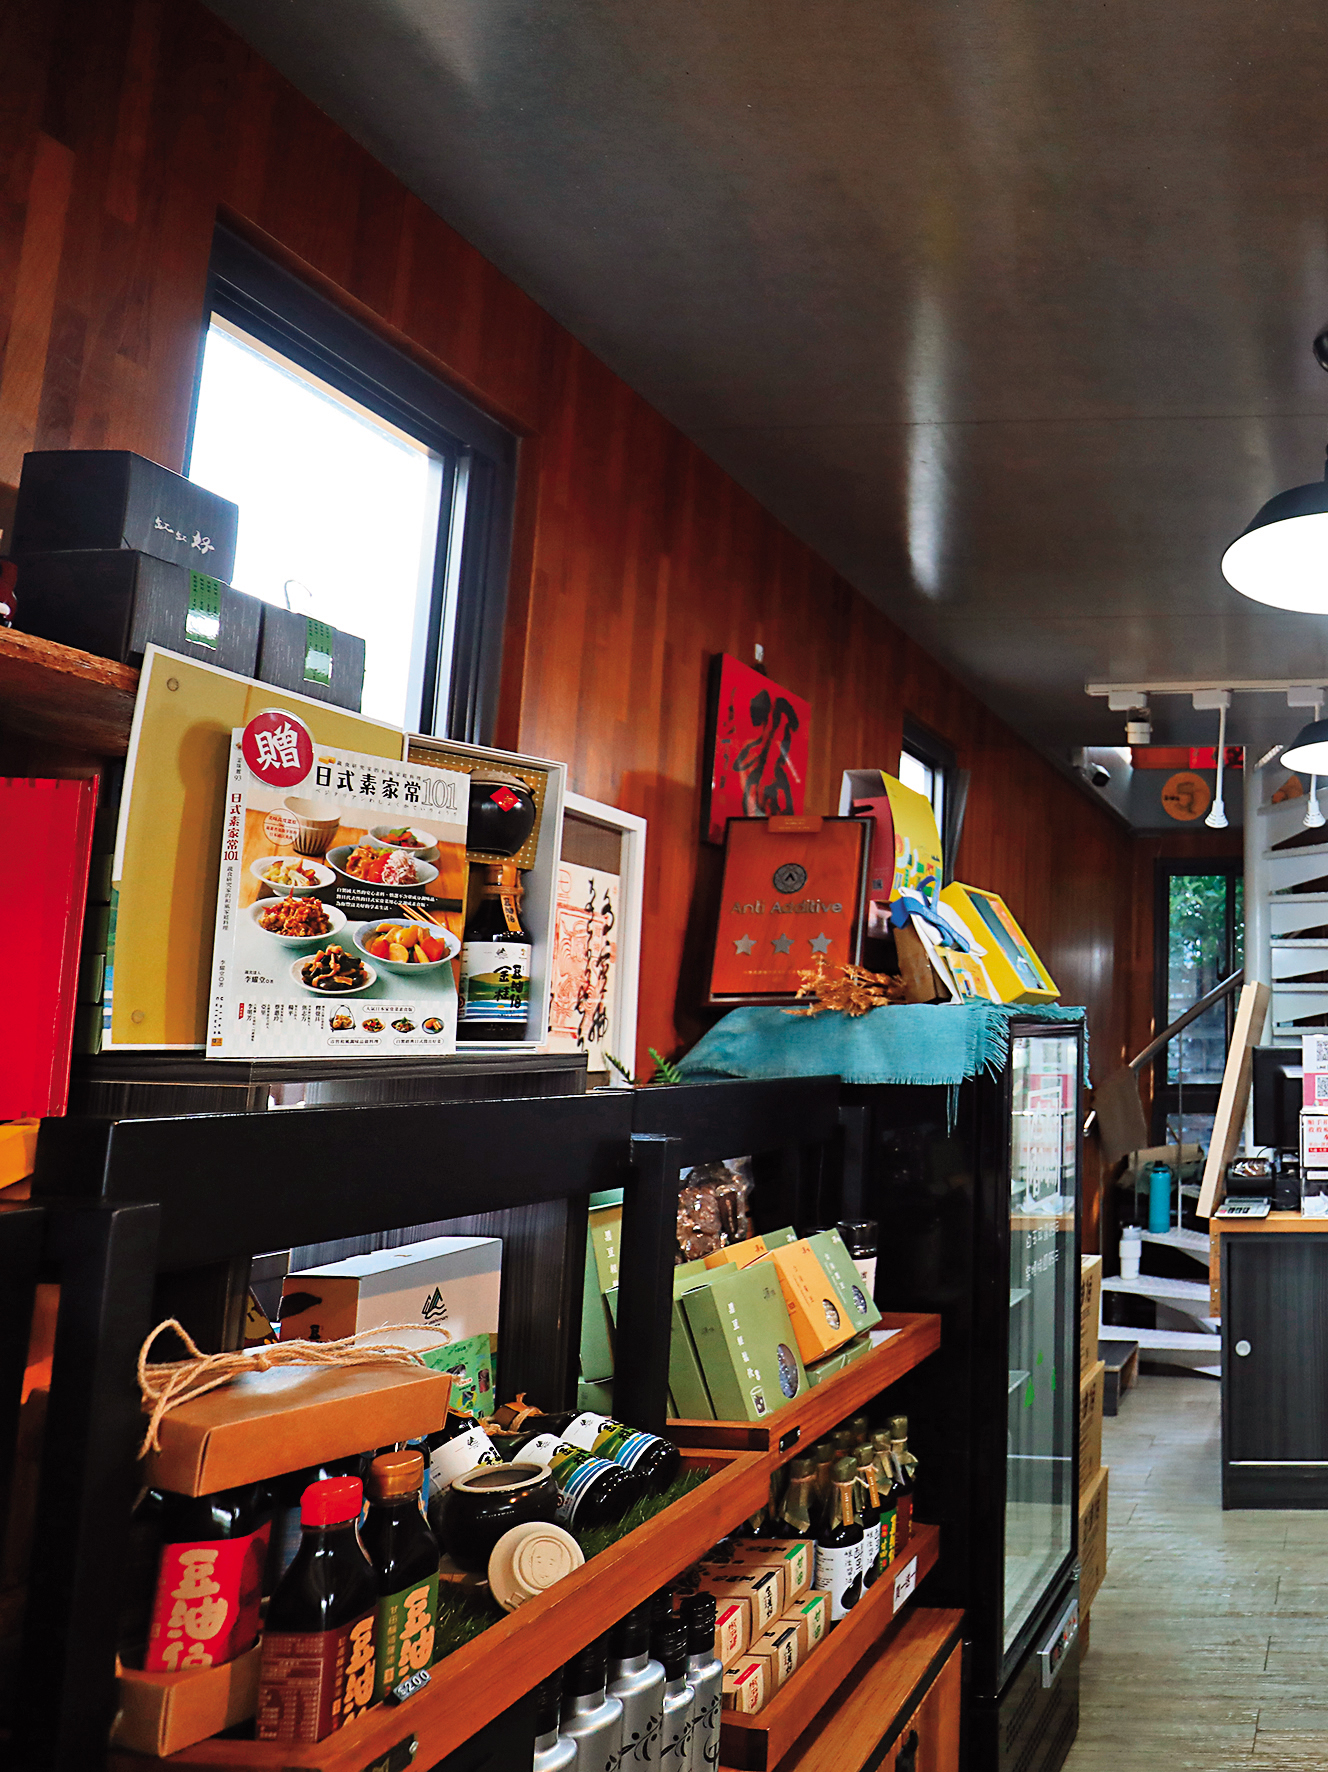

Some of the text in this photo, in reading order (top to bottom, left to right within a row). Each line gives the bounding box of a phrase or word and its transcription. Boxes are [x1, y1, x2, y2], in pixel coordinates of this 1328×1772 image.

[254, 722, 301, 770] 贈
[731, 899, 842, 914] Anti Additive
